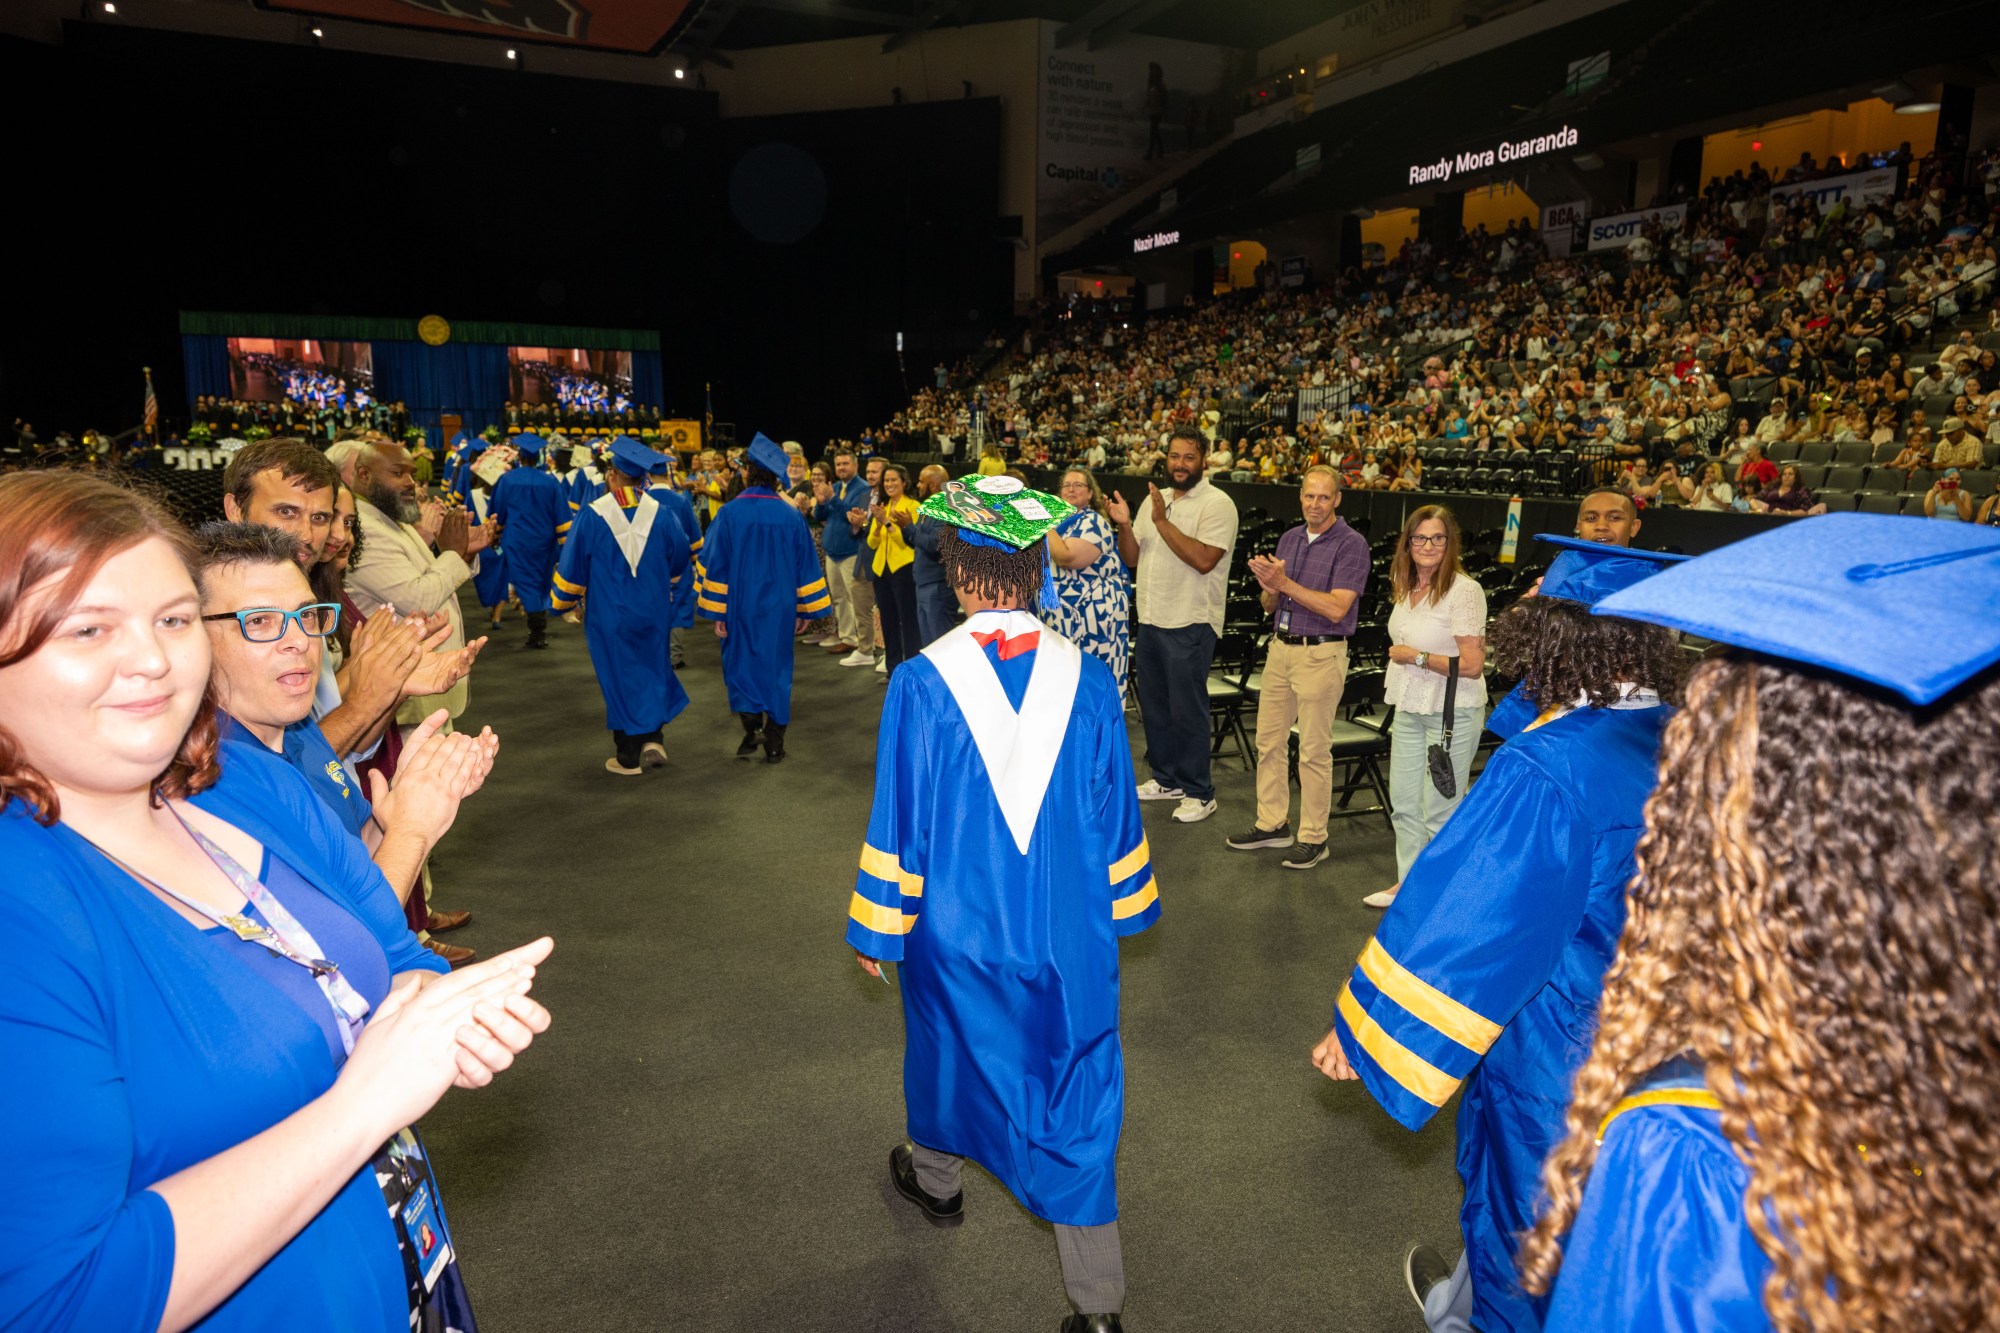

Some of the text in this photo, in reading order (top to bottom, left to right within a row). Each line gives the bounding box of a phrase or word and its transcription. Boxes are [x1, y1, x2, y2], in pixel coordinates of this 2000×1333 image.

[1047, 55, 1096, 75] Connect
[1047, 74, 1113, 92] with nature
[1409, 124, 1579, 185] Randy Mora Guaranda
[1046, 163, 1099, 183] Capital
[1548, 206, 1573, 228] BCA
[1134, 231, 1180, 253] Nazir Moore
[1593, 220, 1649, 242] SCOT
